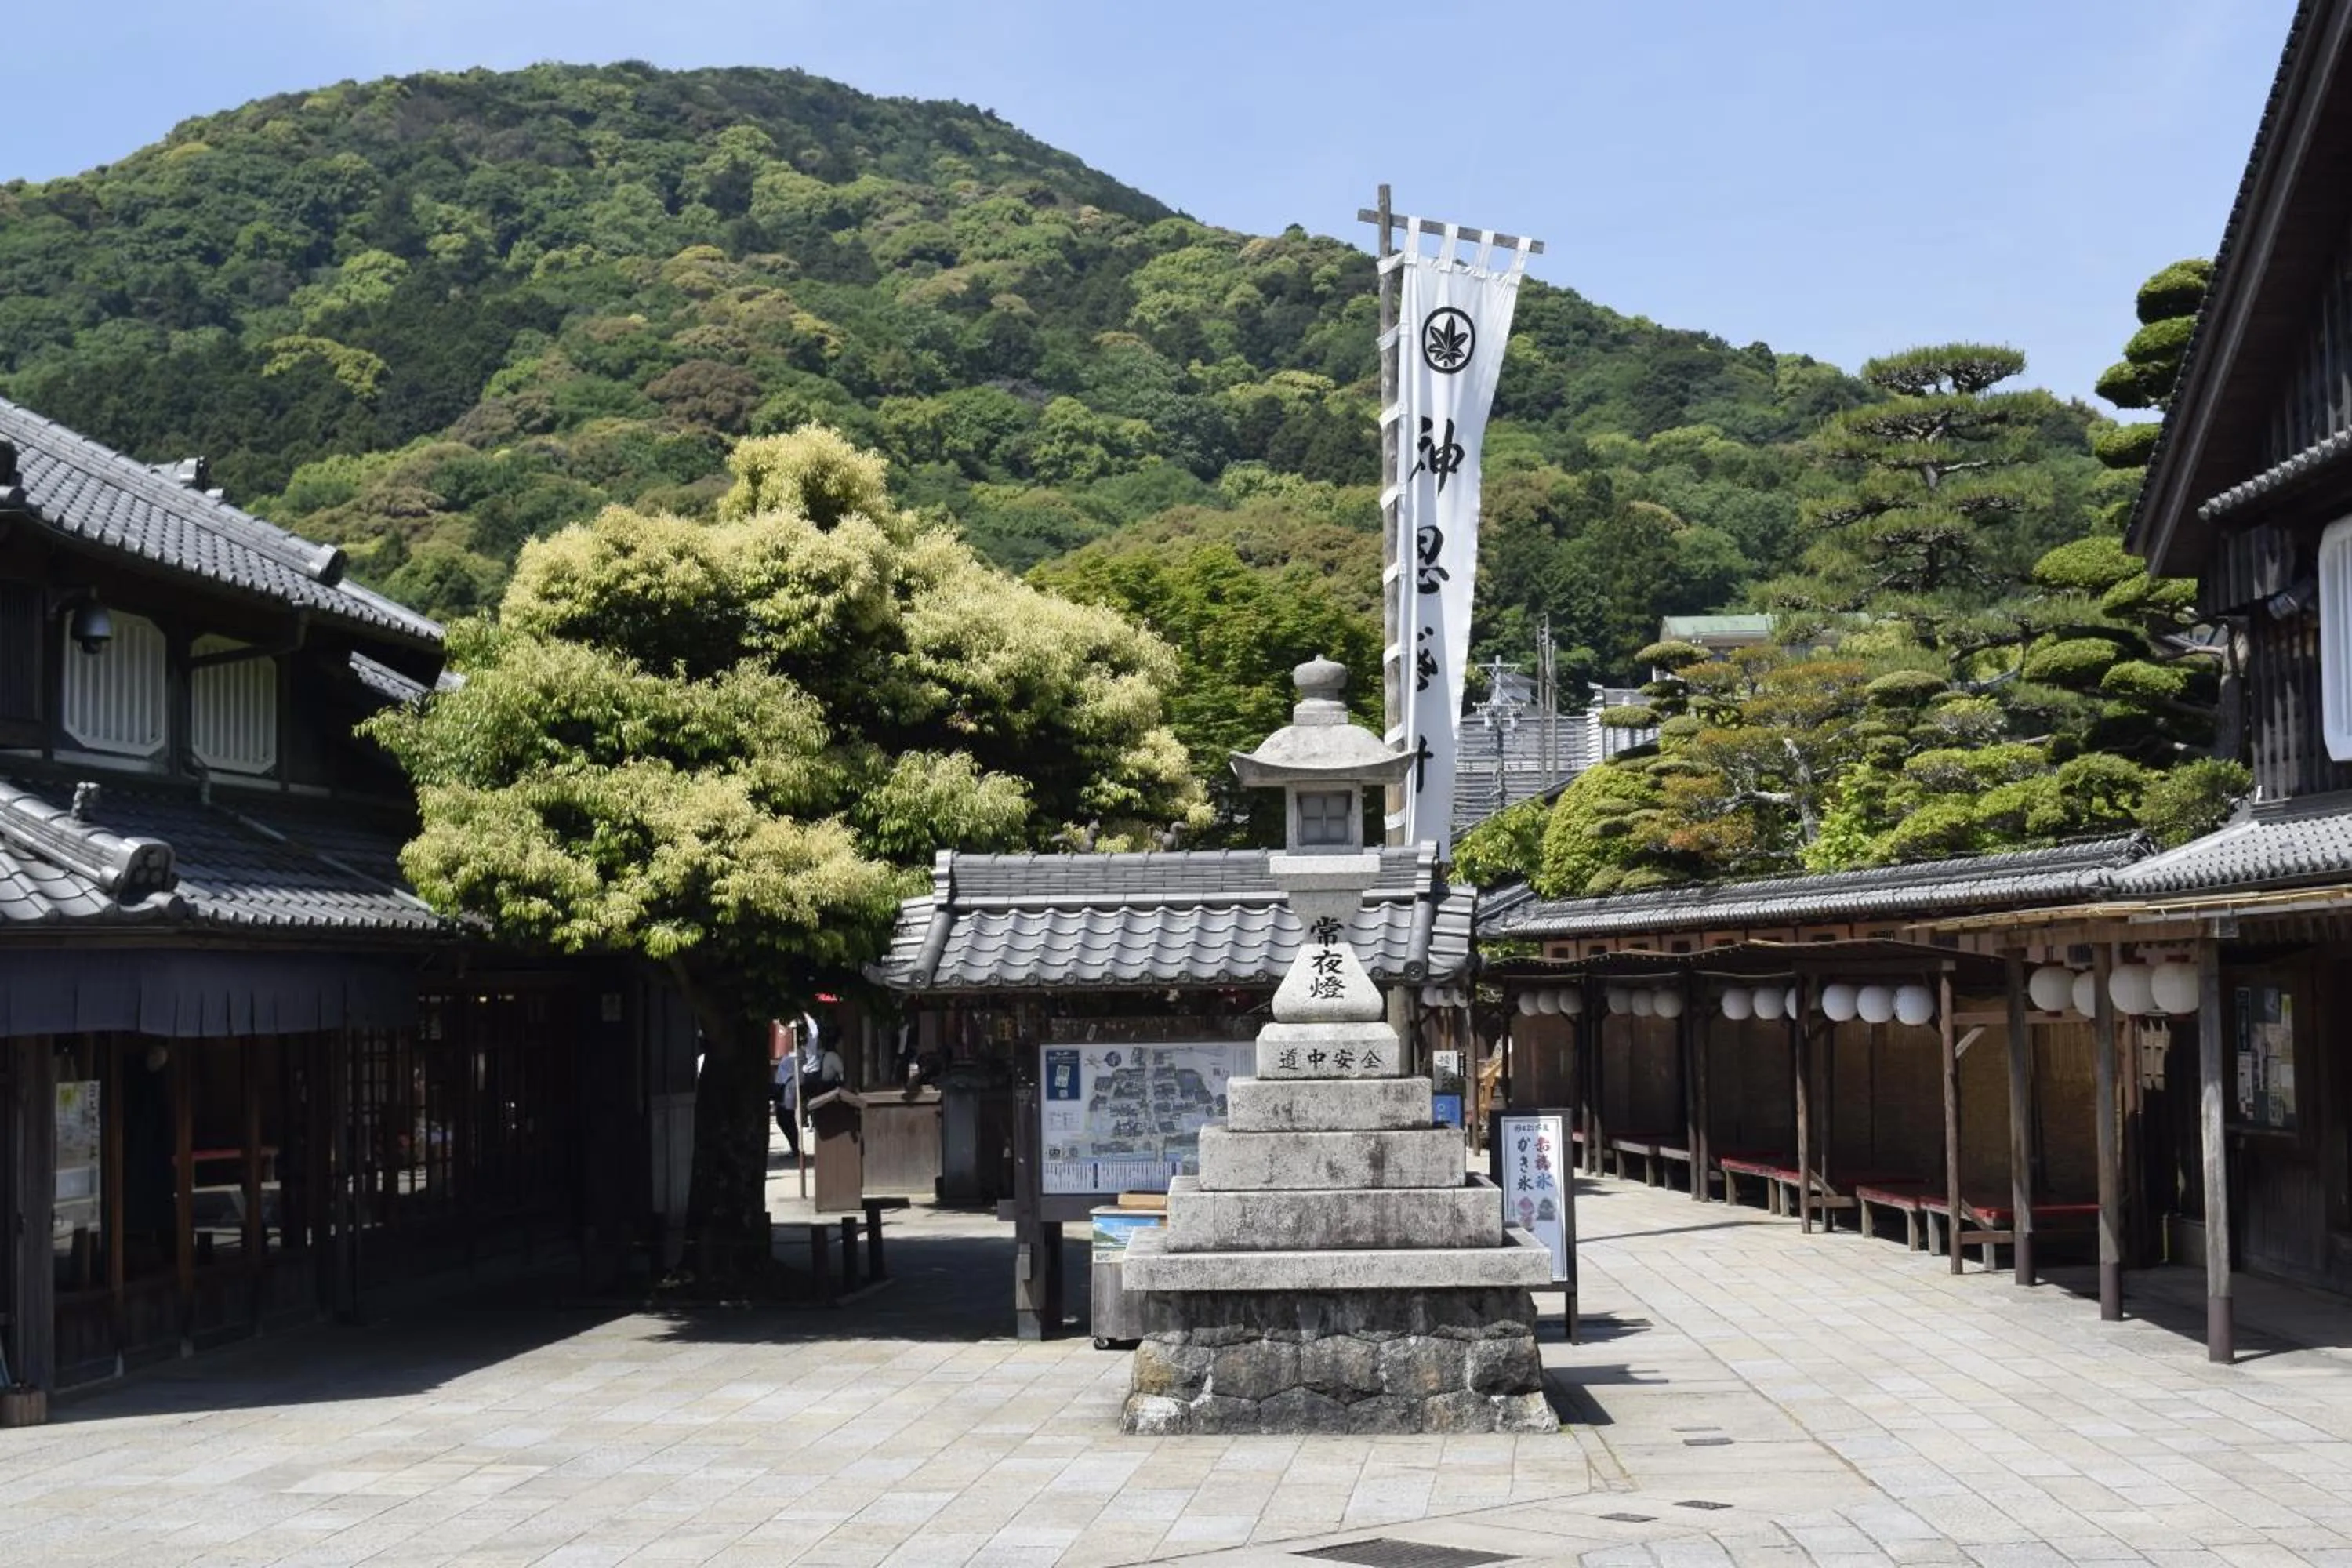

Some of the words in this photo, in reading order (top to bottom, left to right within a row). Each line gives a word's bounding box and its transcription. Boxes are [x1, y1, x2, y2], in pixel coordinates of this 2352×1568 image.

[1309, 916, 1346, 1000] 常夜燈
[1279, 1048, 1384, 1070] 道中安全
[1516, 1136, 1534, 1192] かき氷
